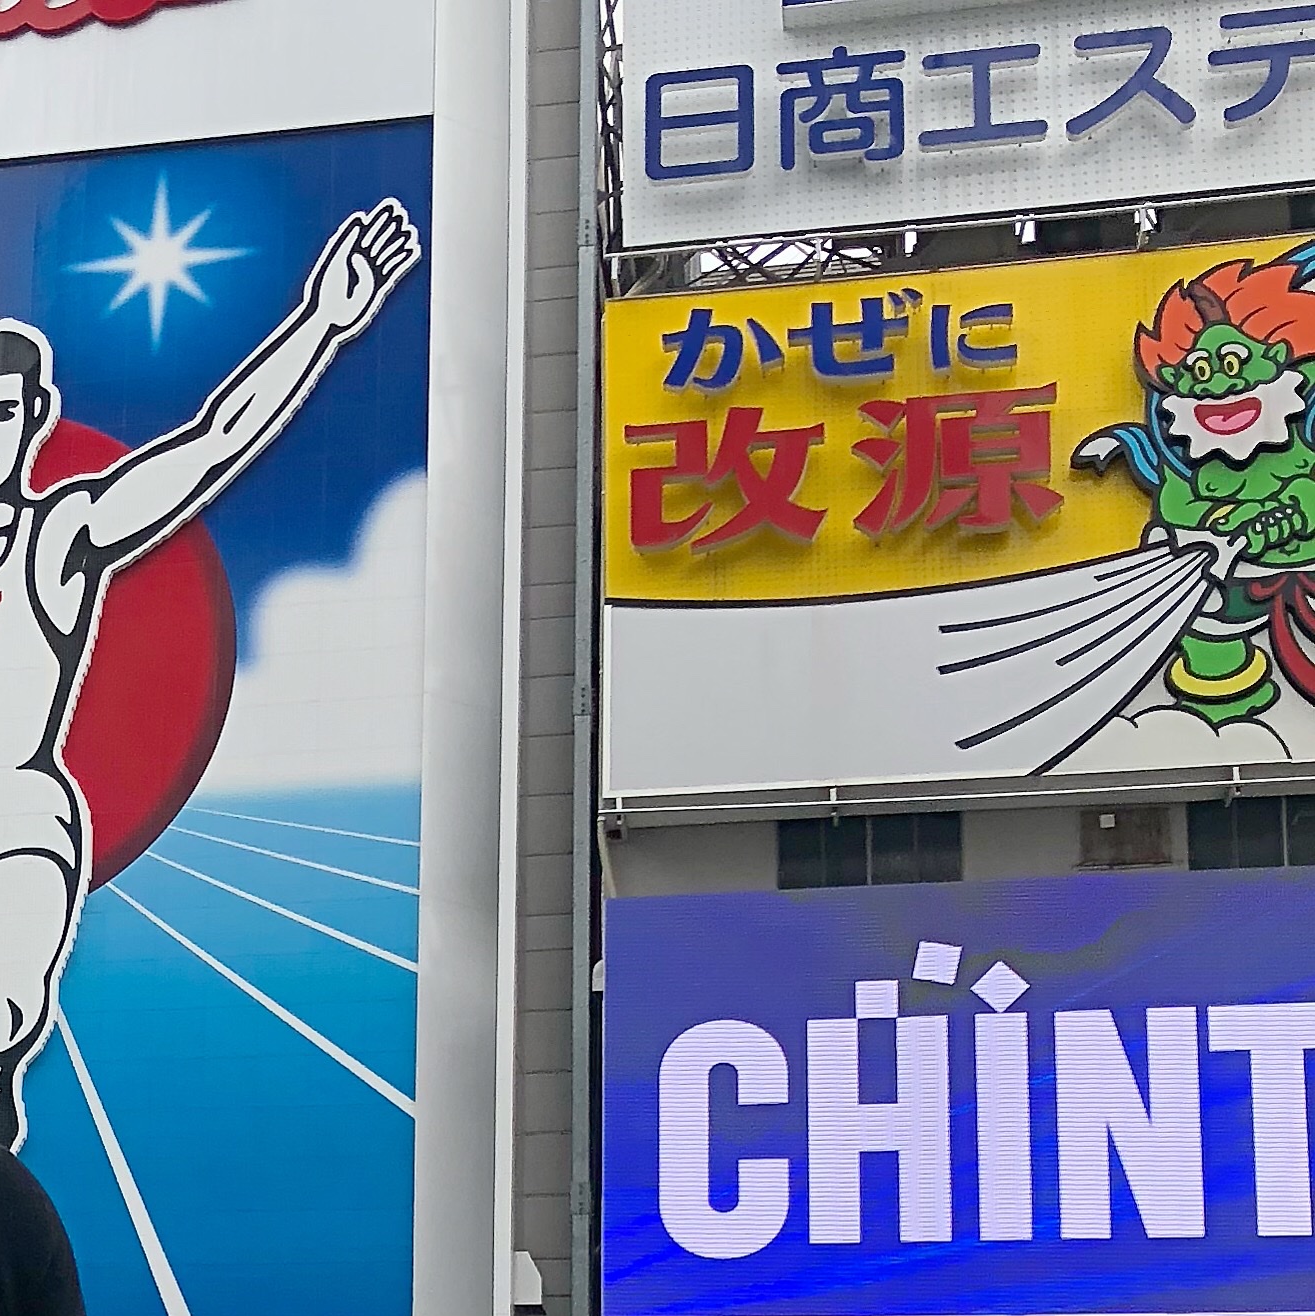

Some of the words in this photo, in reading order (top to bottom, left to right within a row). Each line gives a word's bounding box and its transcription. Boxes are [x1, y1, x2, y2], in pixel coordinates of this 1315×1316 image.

[644, 7, 1315, 180] 日商エステ
[662, 287, 1018, 394] かぜに
[624, 382, 1066, 555] 改源
